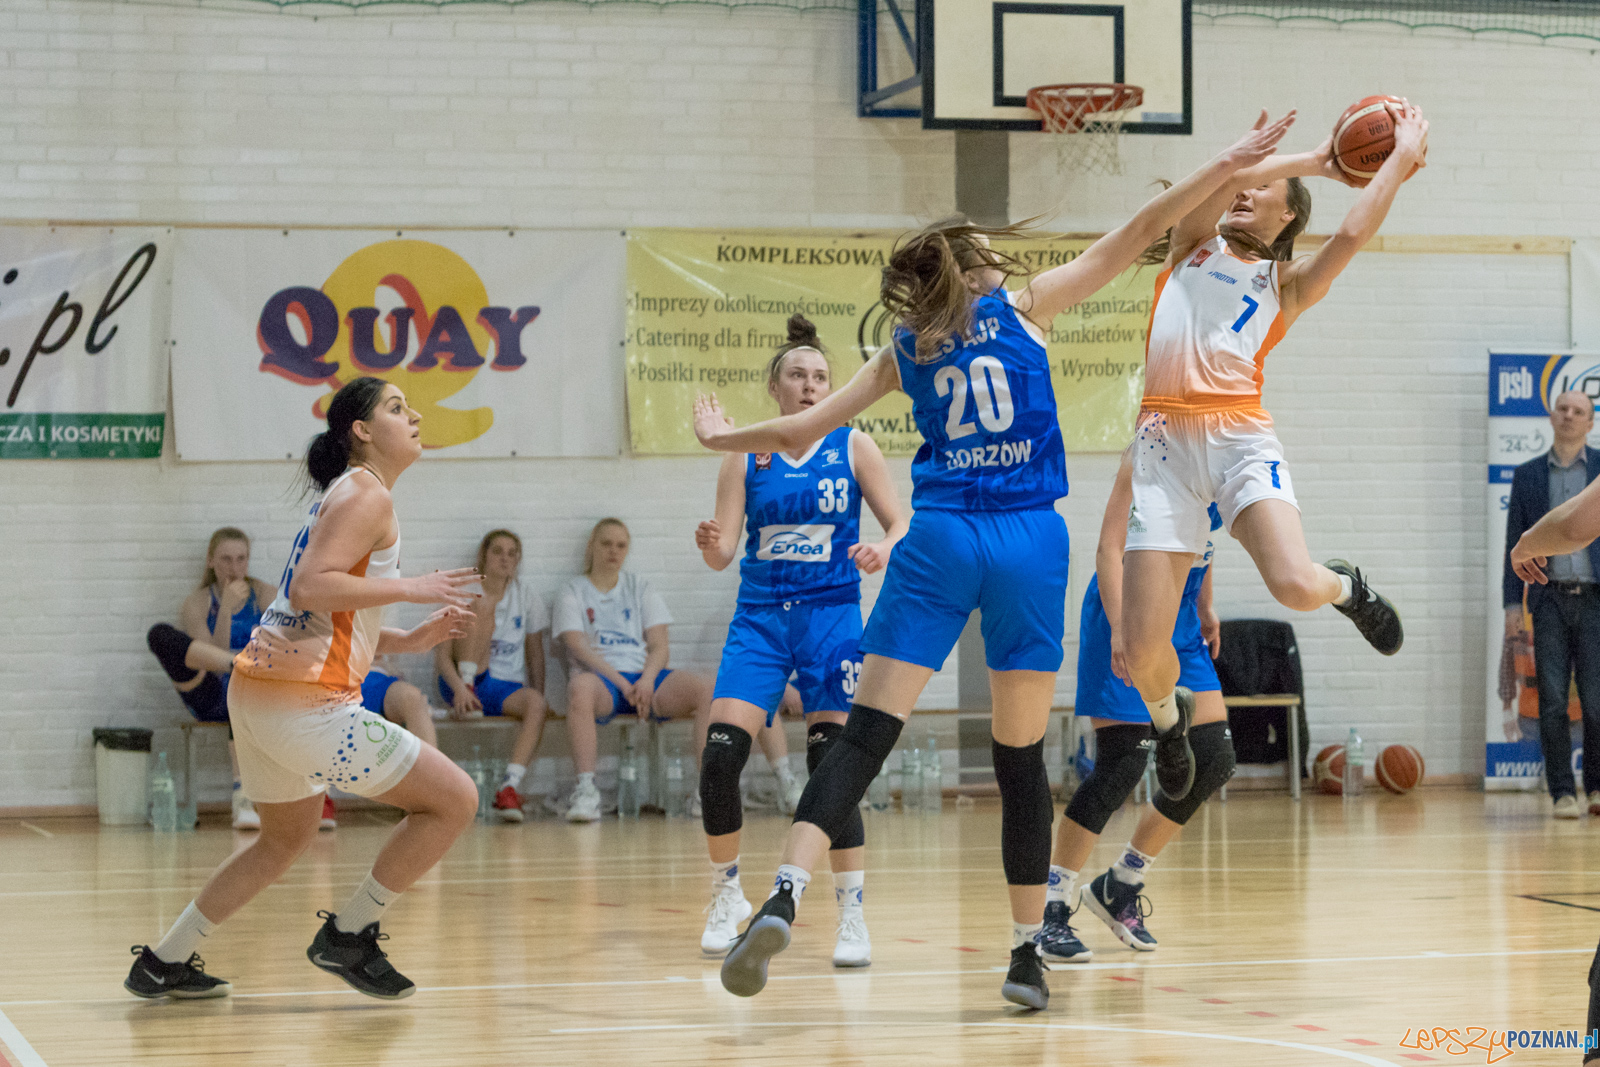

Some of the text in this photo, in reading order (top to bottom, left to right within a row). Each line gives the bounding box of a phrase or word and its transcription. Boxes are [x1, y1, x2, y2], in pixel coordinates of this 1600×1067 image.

[716, 244, 886, 266] KOMPLEKSOWA
[635, 292, 856, 317] Imprezy okolicznościowe
[1231, 294, 1259, 333] 7
[0, 242, 157, 408] .pl
[256, 285, 541, 385] QUAY
[1050, 324, 1135, 343] bankietów
[636, 327, 784, 352] Catering dla firm
[638, 362, 694, 382] Posiłki
[1062, 357, 1125, 382] Wyroby
[934, 355, 1014, 441] 20
[1498, 366, 1533, 405] psb
[39, 426, 46, 442] I
[51, 425, 161, 443] KOSMETYKI
[818, 478, 849, 513] 33
[770, 540, 824, 556] Enea
